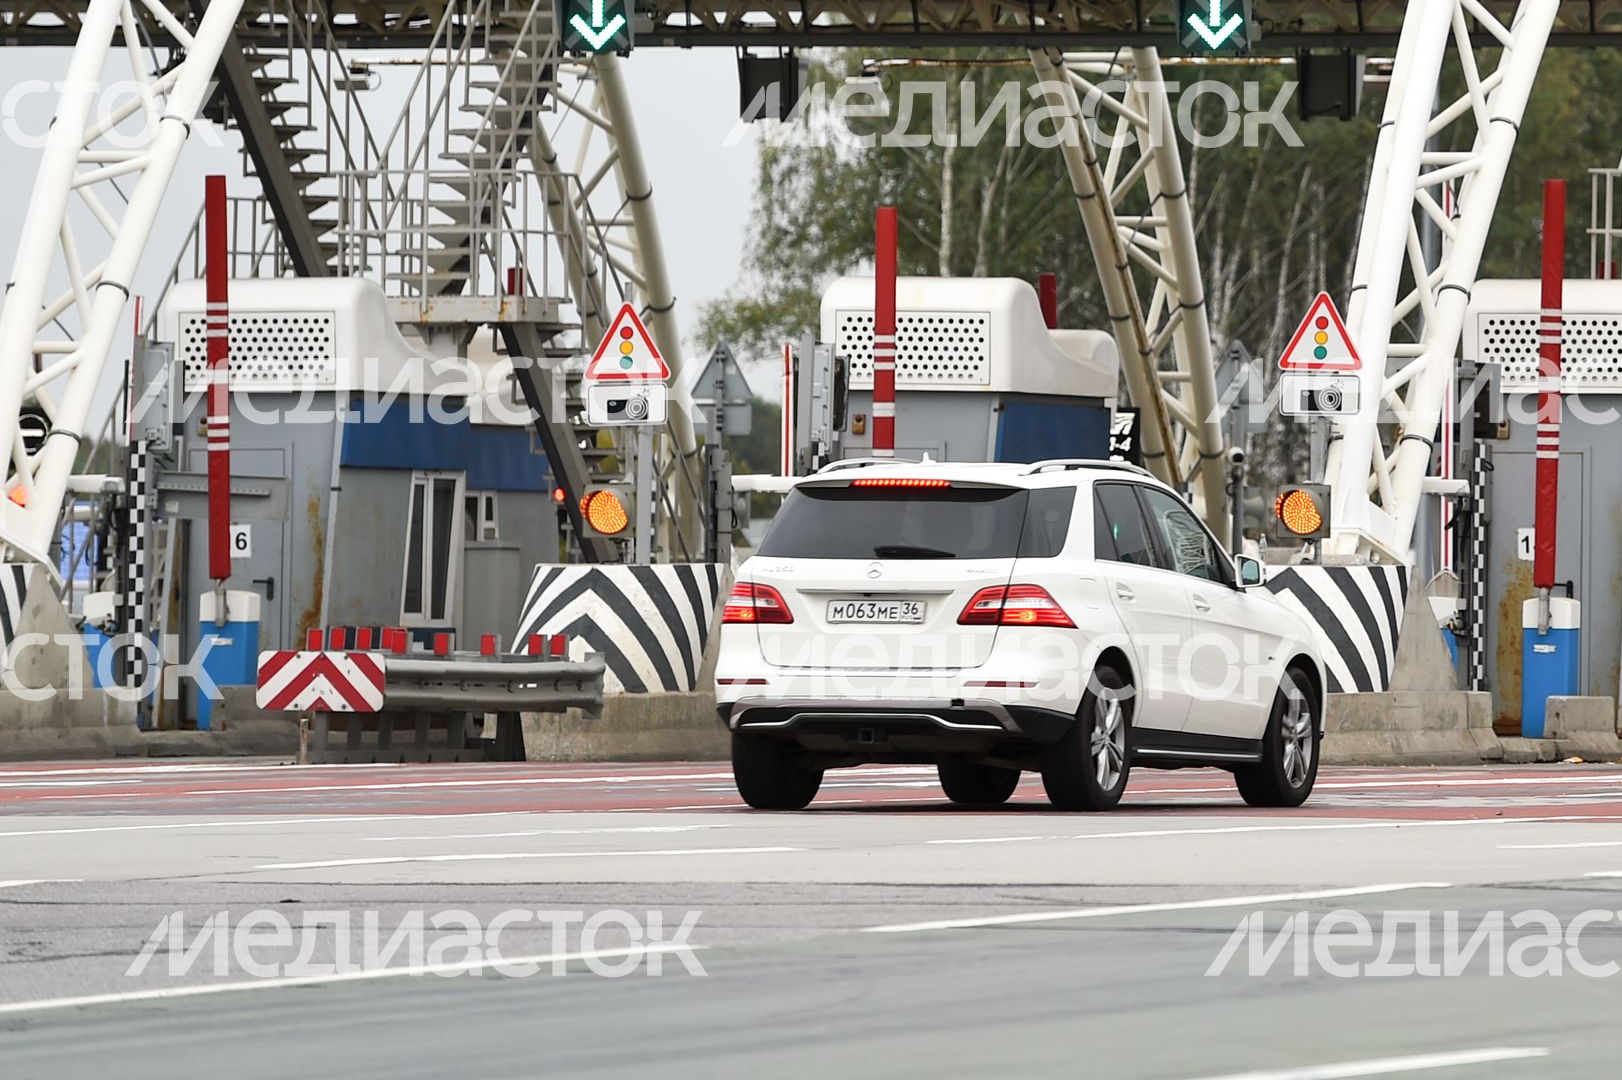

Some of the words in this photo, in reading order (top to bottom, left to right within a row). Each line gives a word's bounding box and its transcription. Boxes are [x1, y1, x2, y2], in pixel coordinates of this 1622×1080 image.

[235, 531, 248, 551] 6
[832, 603, 898, 620] М063МЕ
[902, 602, 919, 615] 36
